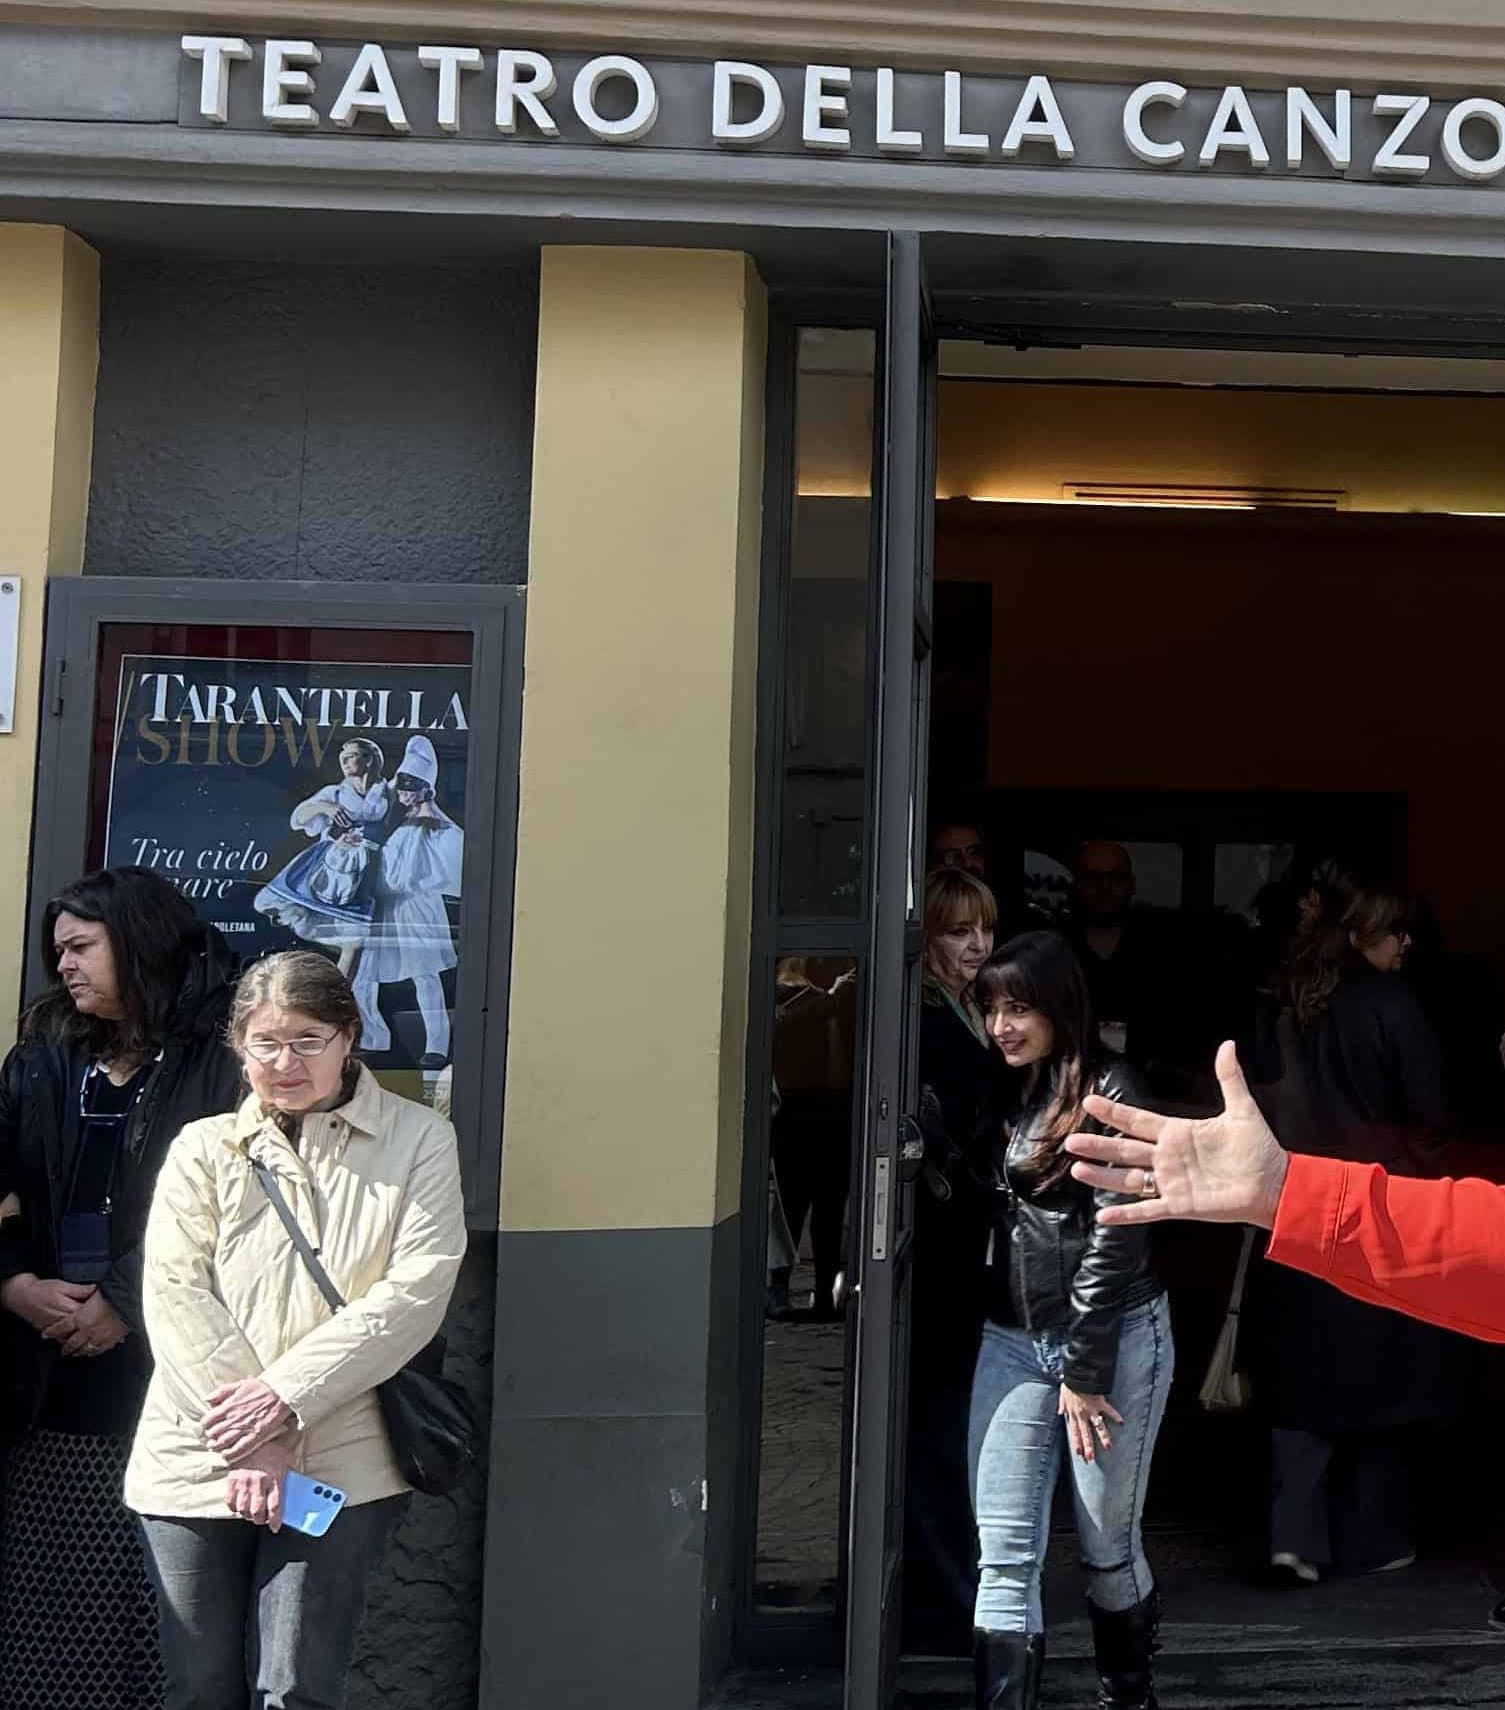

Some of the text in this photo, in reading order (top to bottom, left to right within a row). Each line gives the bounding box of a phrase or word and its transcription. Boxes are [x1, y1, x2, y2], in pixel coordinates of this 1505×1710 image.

[181, 34, 658, 144] TEATRO
[710, 60, 1075, 161] DELLA
[140, 673, 470, 730] TARANTELLA
[136, 714, 339, 767] SHOW
[131, 838, 268, 870] Tra cielo
